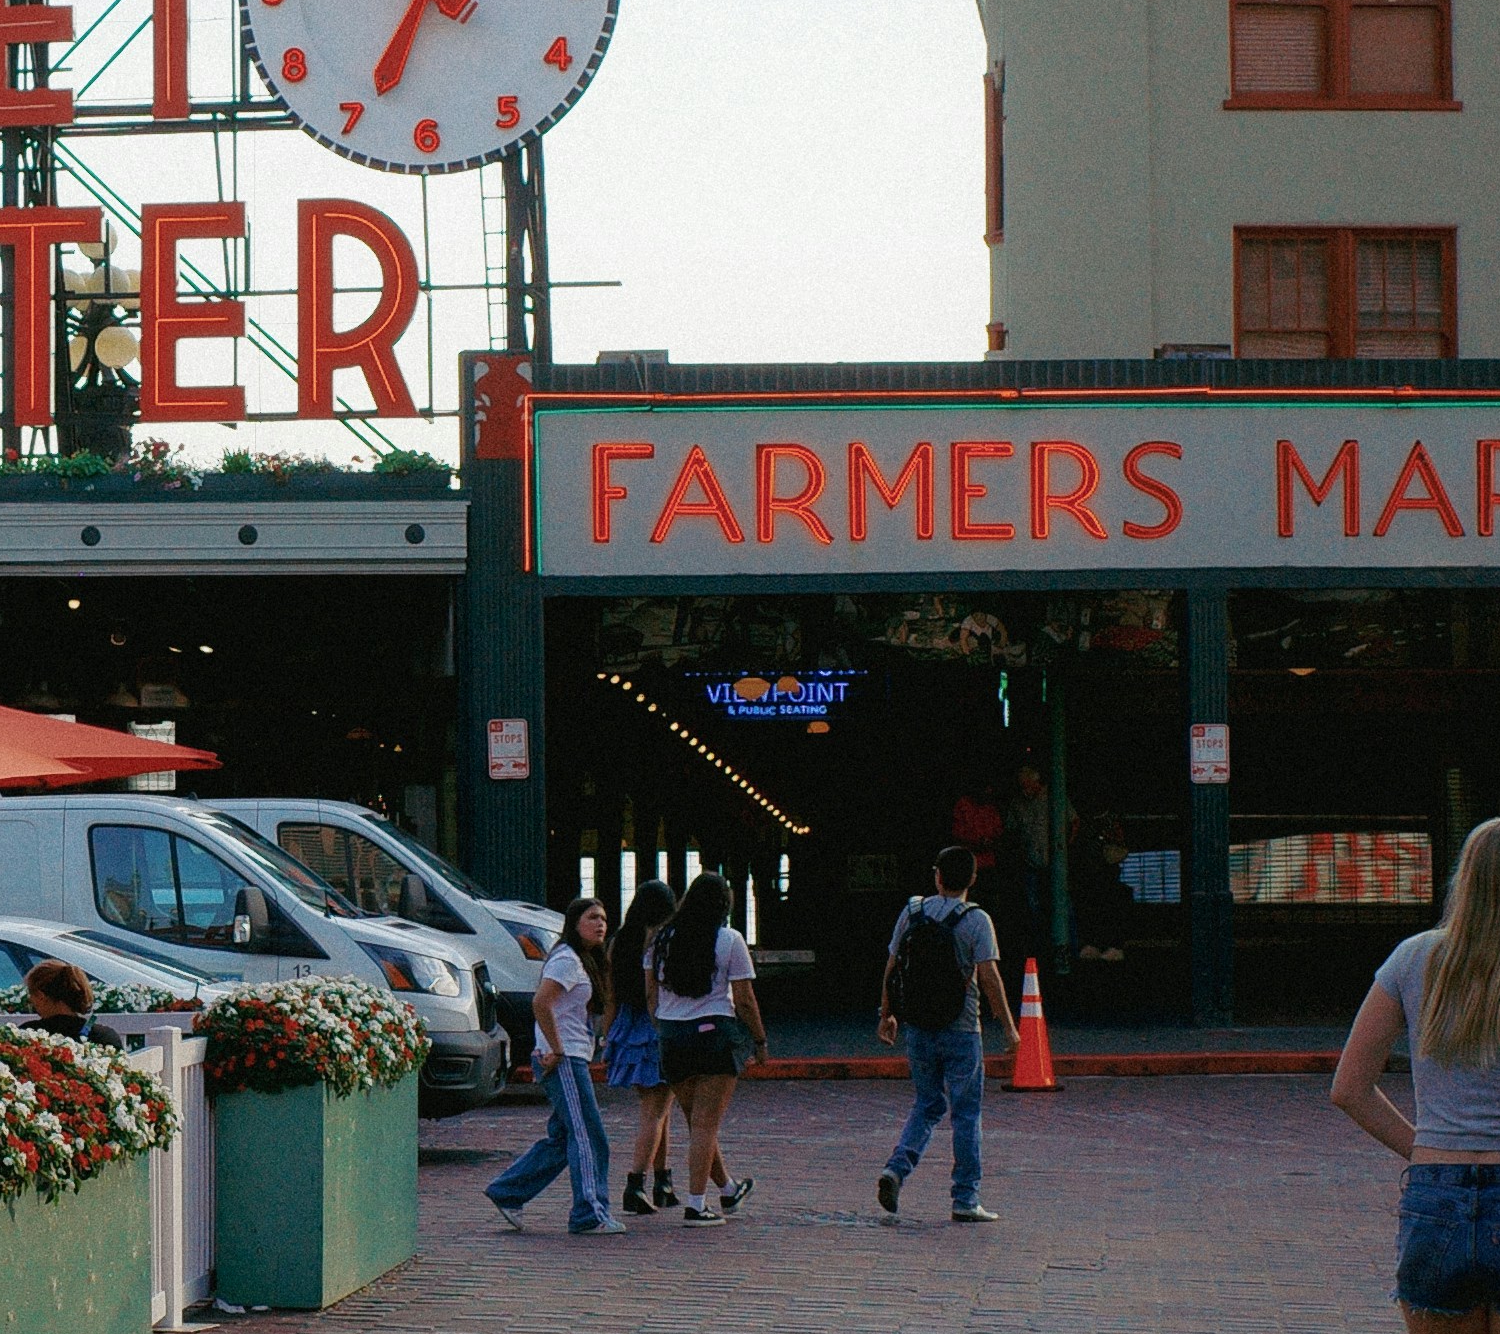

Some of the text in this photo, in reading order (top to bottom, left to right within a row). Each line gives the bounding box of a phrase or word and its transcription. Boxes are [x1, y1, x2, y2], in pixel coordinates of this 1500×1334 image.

[282, 47, 307, 82] 8
[543, 36, 573, 71] 4
[339, 102, 365, 135] 7
[496, 95, 520, 129] 5
[413, 118, 441, 153] 6
[593, 441, 1182, 543] FARMERS
[738, 705, 776, 716] PUBLIC
[780, 704, 827, 715] SEATING
[494, 734, 522, 744] STOPS
[1196, 739, 1224, 749] STOPS
[294, 964, 311, 979] 13
